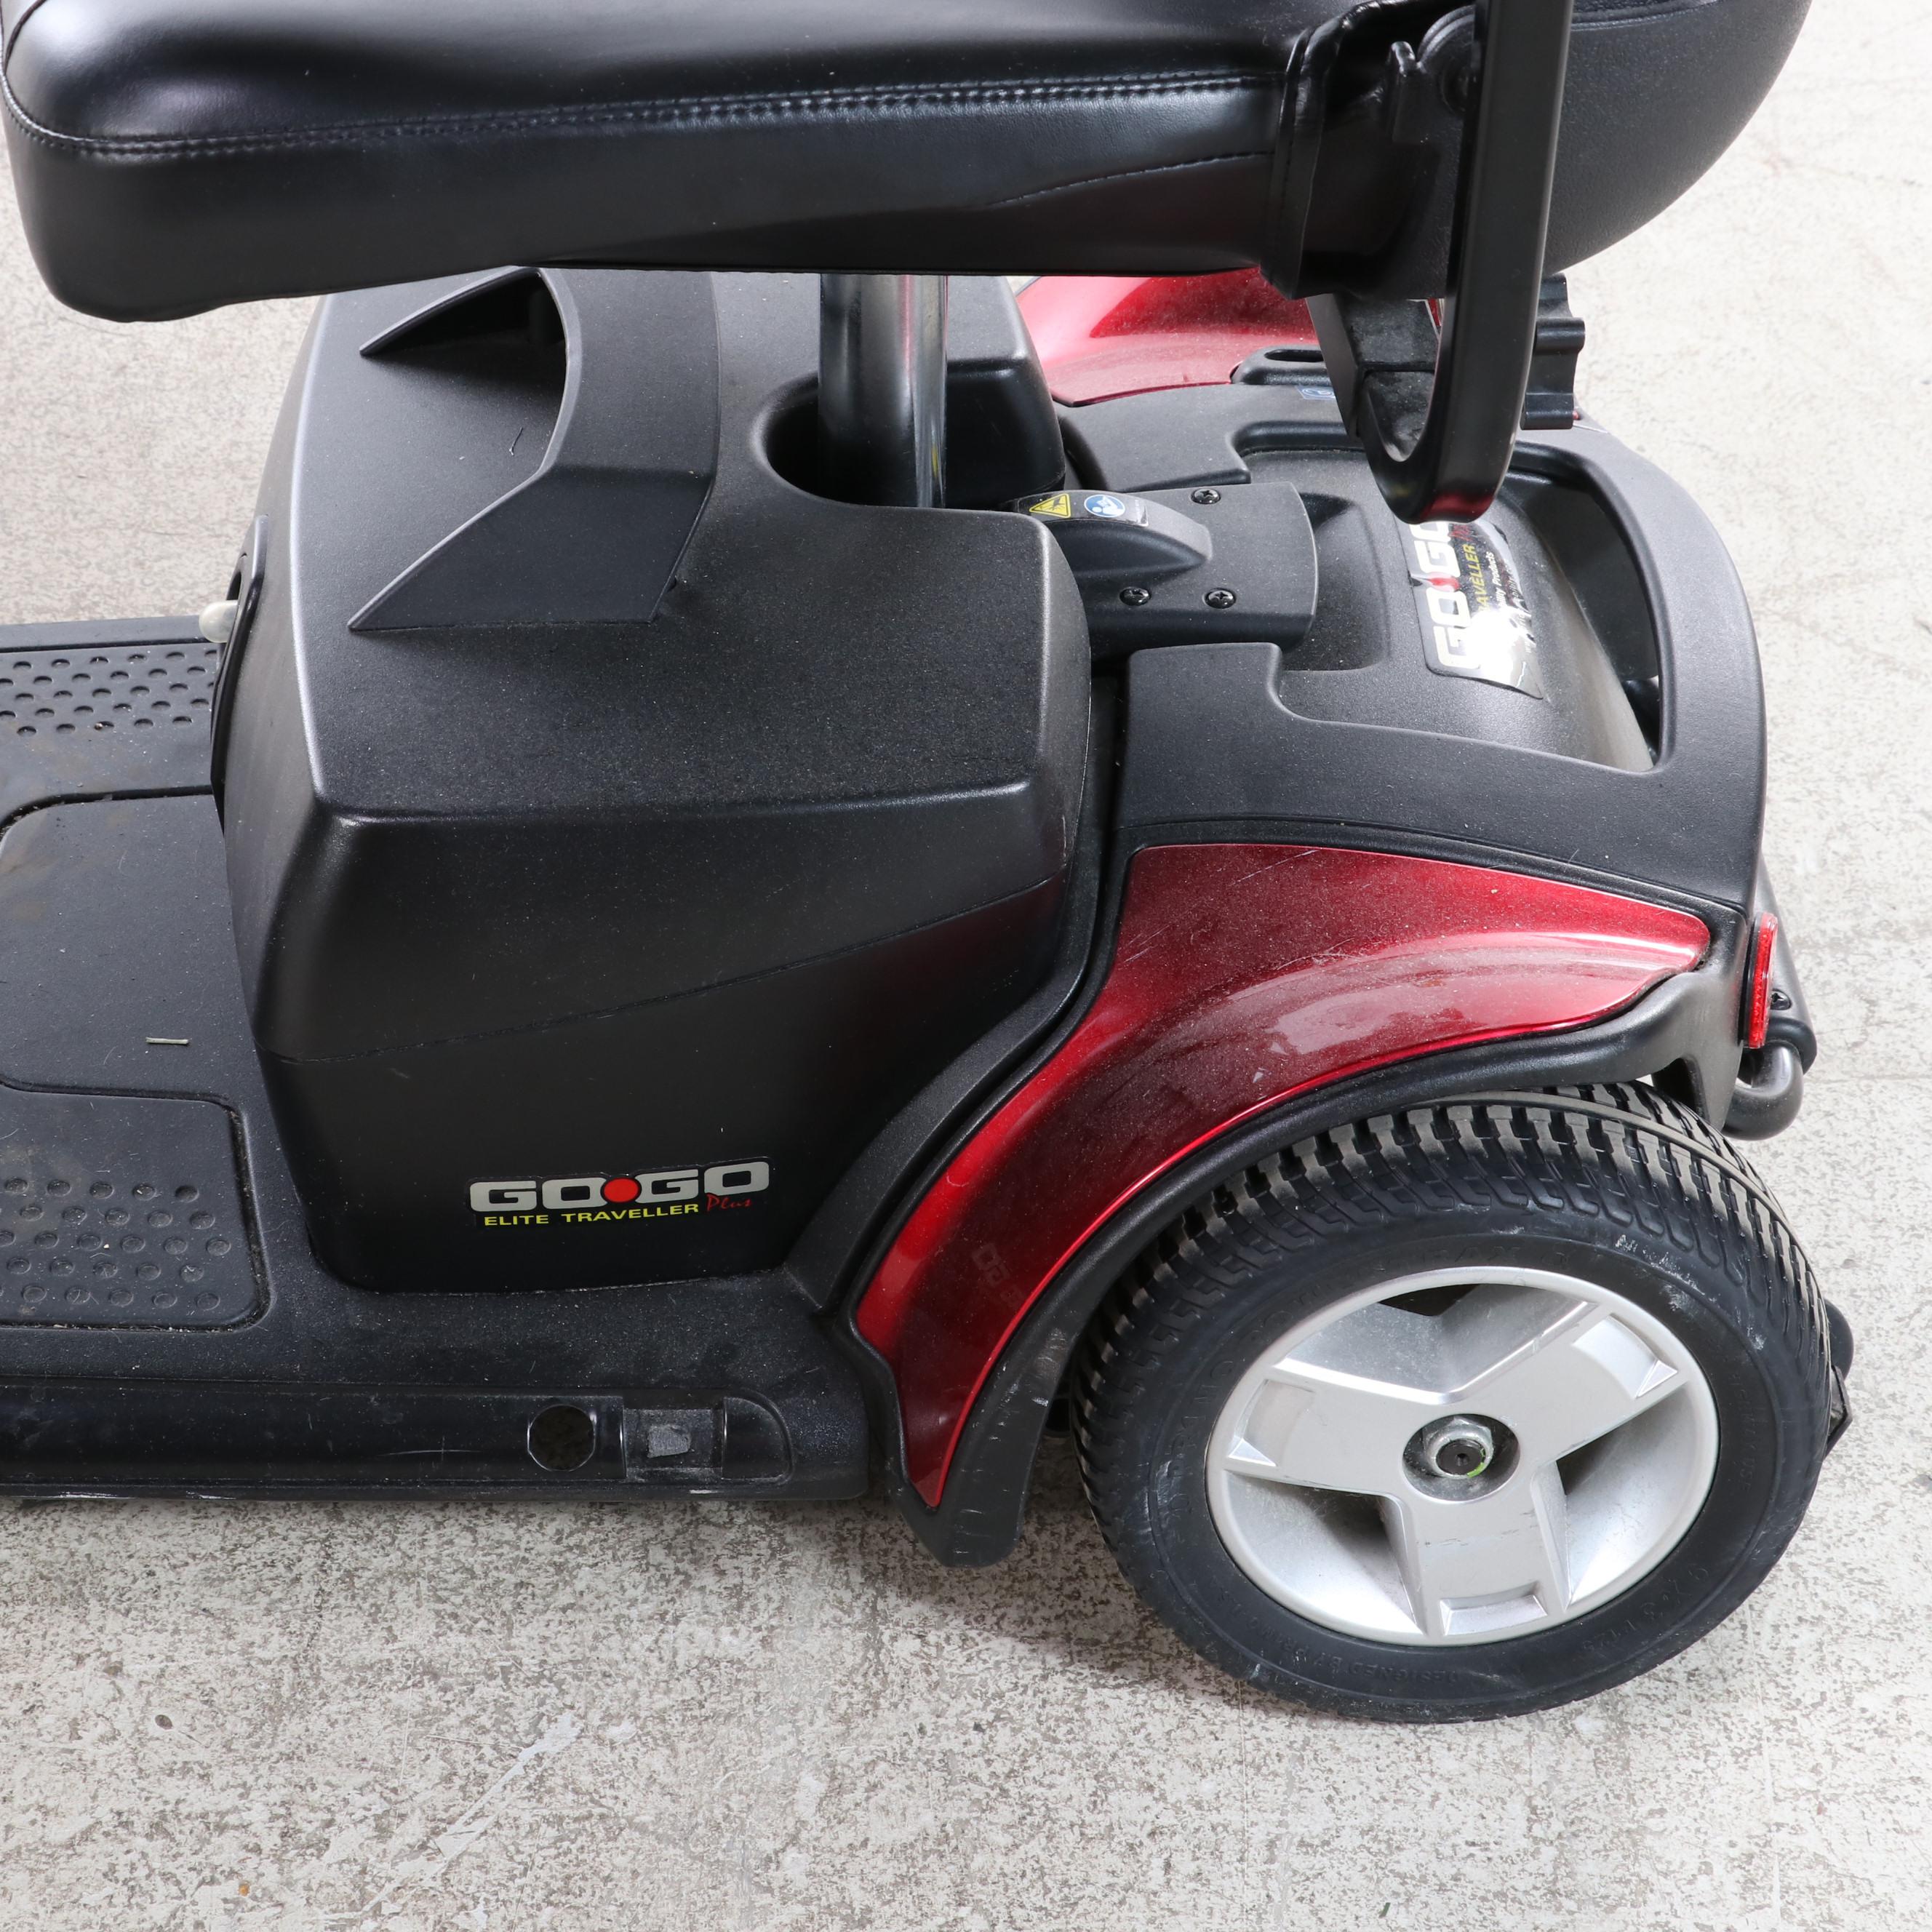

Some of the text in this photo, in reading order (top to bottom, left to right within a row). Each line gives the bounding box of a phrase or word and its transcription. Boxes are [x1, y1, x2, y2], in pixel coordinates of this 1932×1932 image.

[484, 1192, 753, 1226] ELITE TRAVELLER Plus
